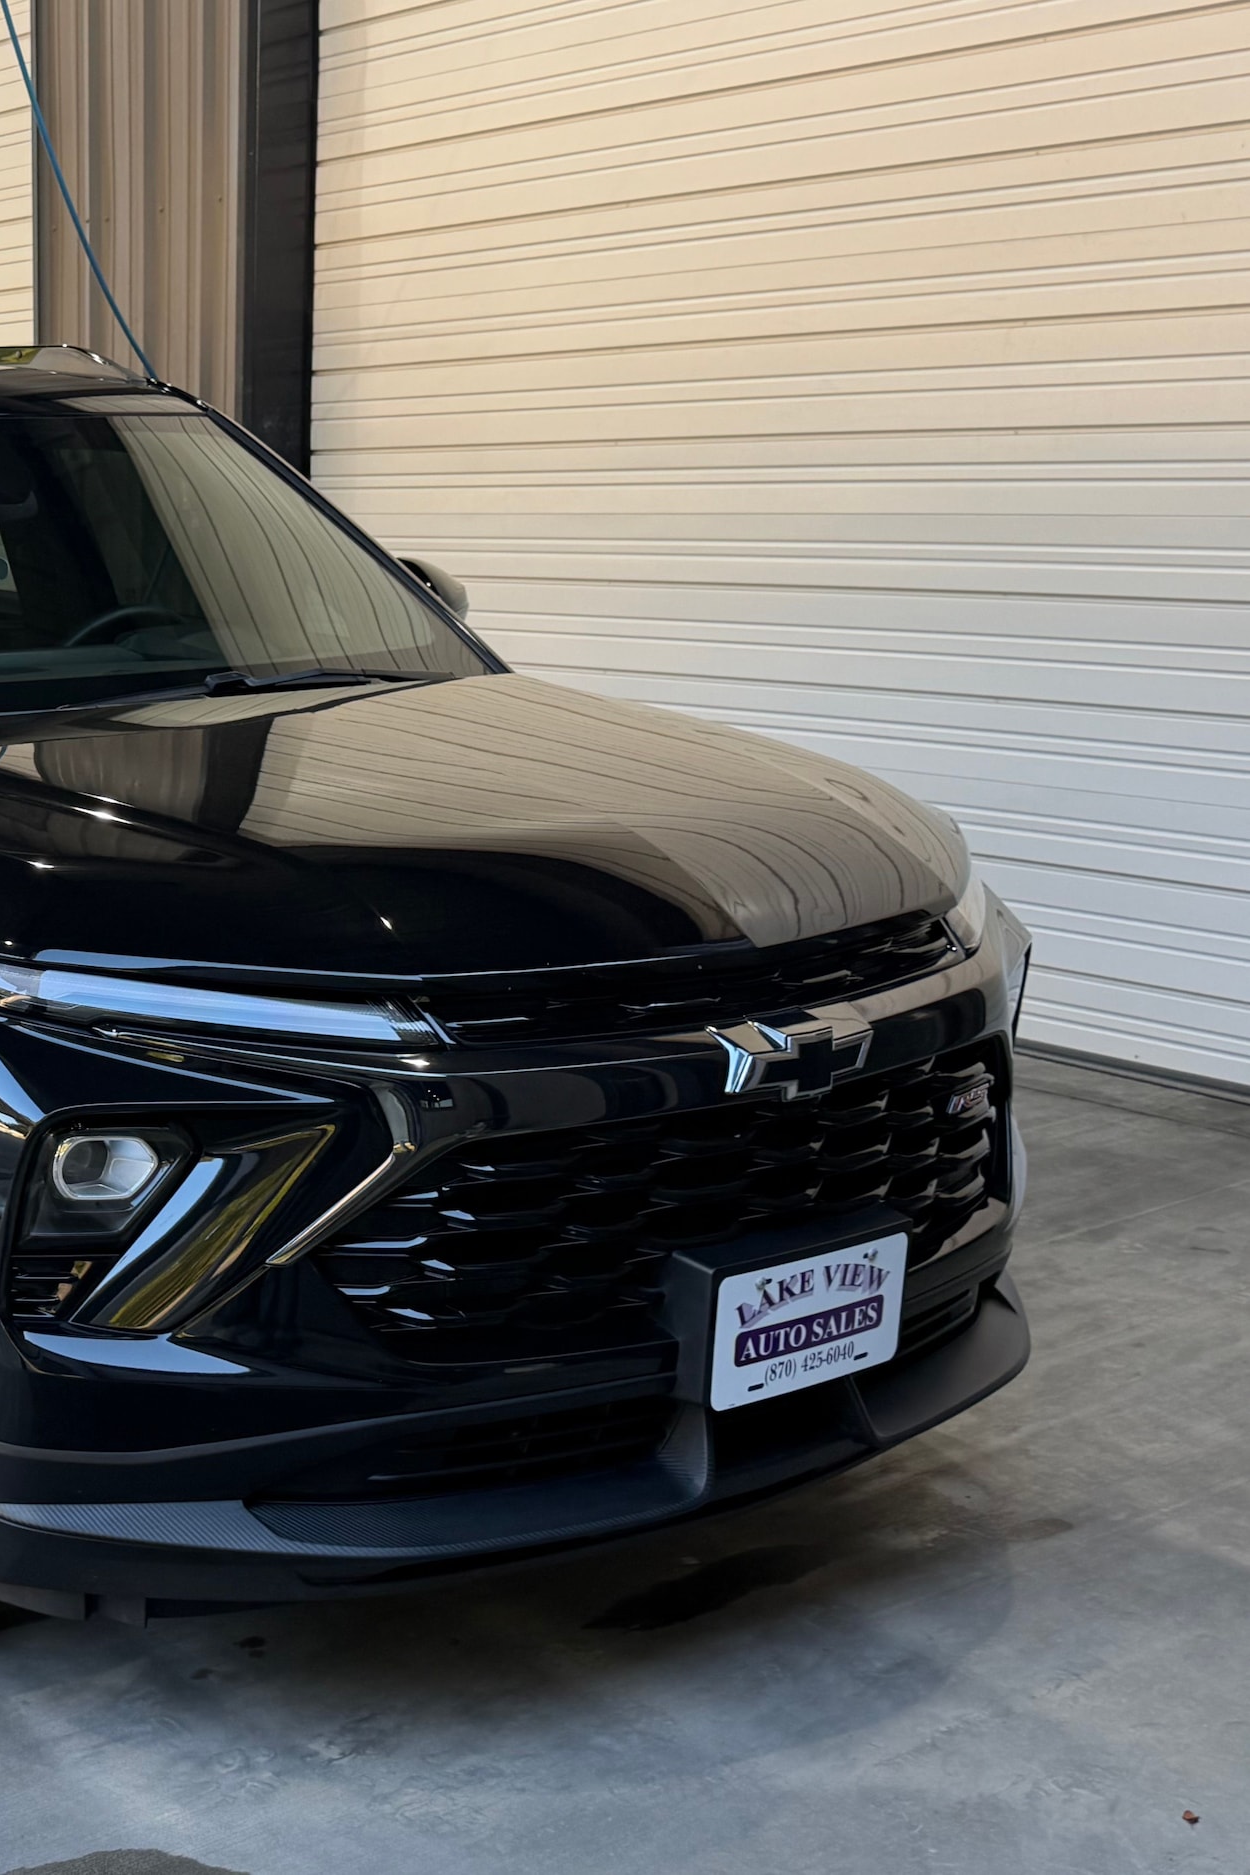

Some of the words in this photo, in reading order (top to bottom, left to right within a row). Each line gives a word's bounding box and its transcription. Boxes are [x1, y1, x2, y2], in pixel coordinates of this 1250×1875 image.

[734, 1269, 814, 1328] LAKE
[823, 1263, 891, 1294] VIEW
[739, 1324, 807, 1362] AUTO
[811, 1302, 879, 1342] SALES
[763, 1358, 797, 1387] (870)
[800, 1340, 855, 1373] 425-6040
